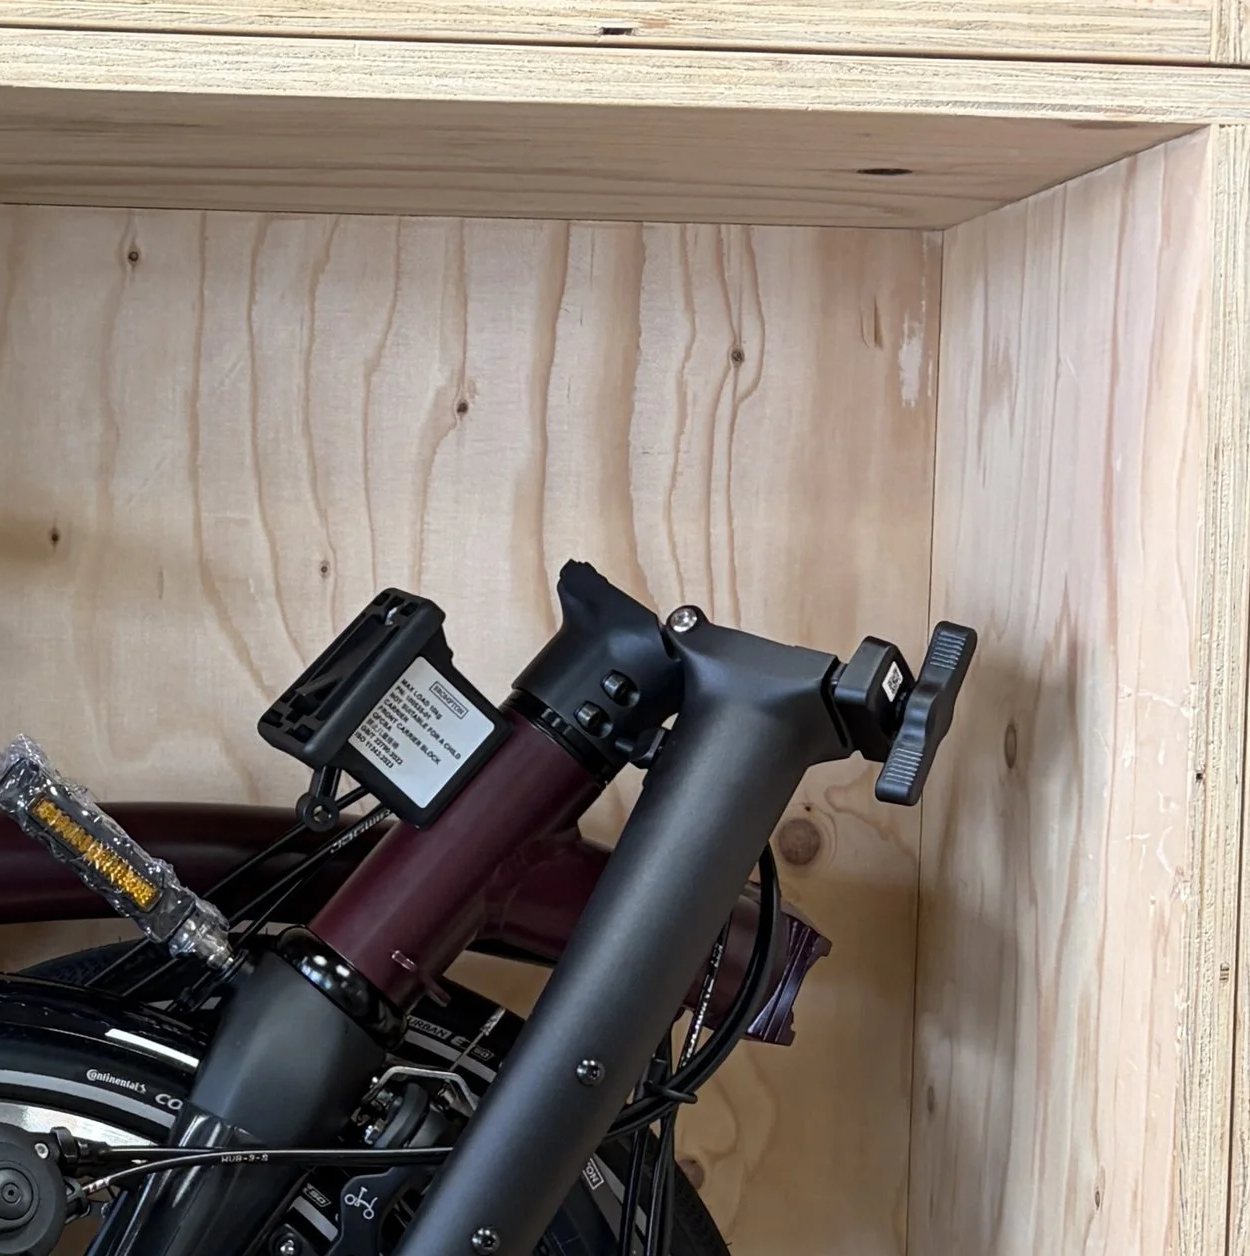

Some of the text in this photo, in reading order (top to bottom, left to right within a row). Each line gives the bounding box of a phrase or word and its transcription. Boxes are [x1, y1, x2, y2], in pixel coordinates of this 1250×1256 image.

[400, 678, 415, 692] MAX
[413, 690, 430, 707] LOAD
[383, 698, 409, 723] CARRIER
[354, 731, 366, 743] ISO
[377, 704, 441, 765] FRONT CARRIER BLOCK
[389, 691, 403, 704] NOT
[401, 703, 429, 729] SUITABLE
[426, 727, 441, 741] FOR
[443, 742, 461, 760] CHILD
[86, 1068, 139, 1091] Continental
